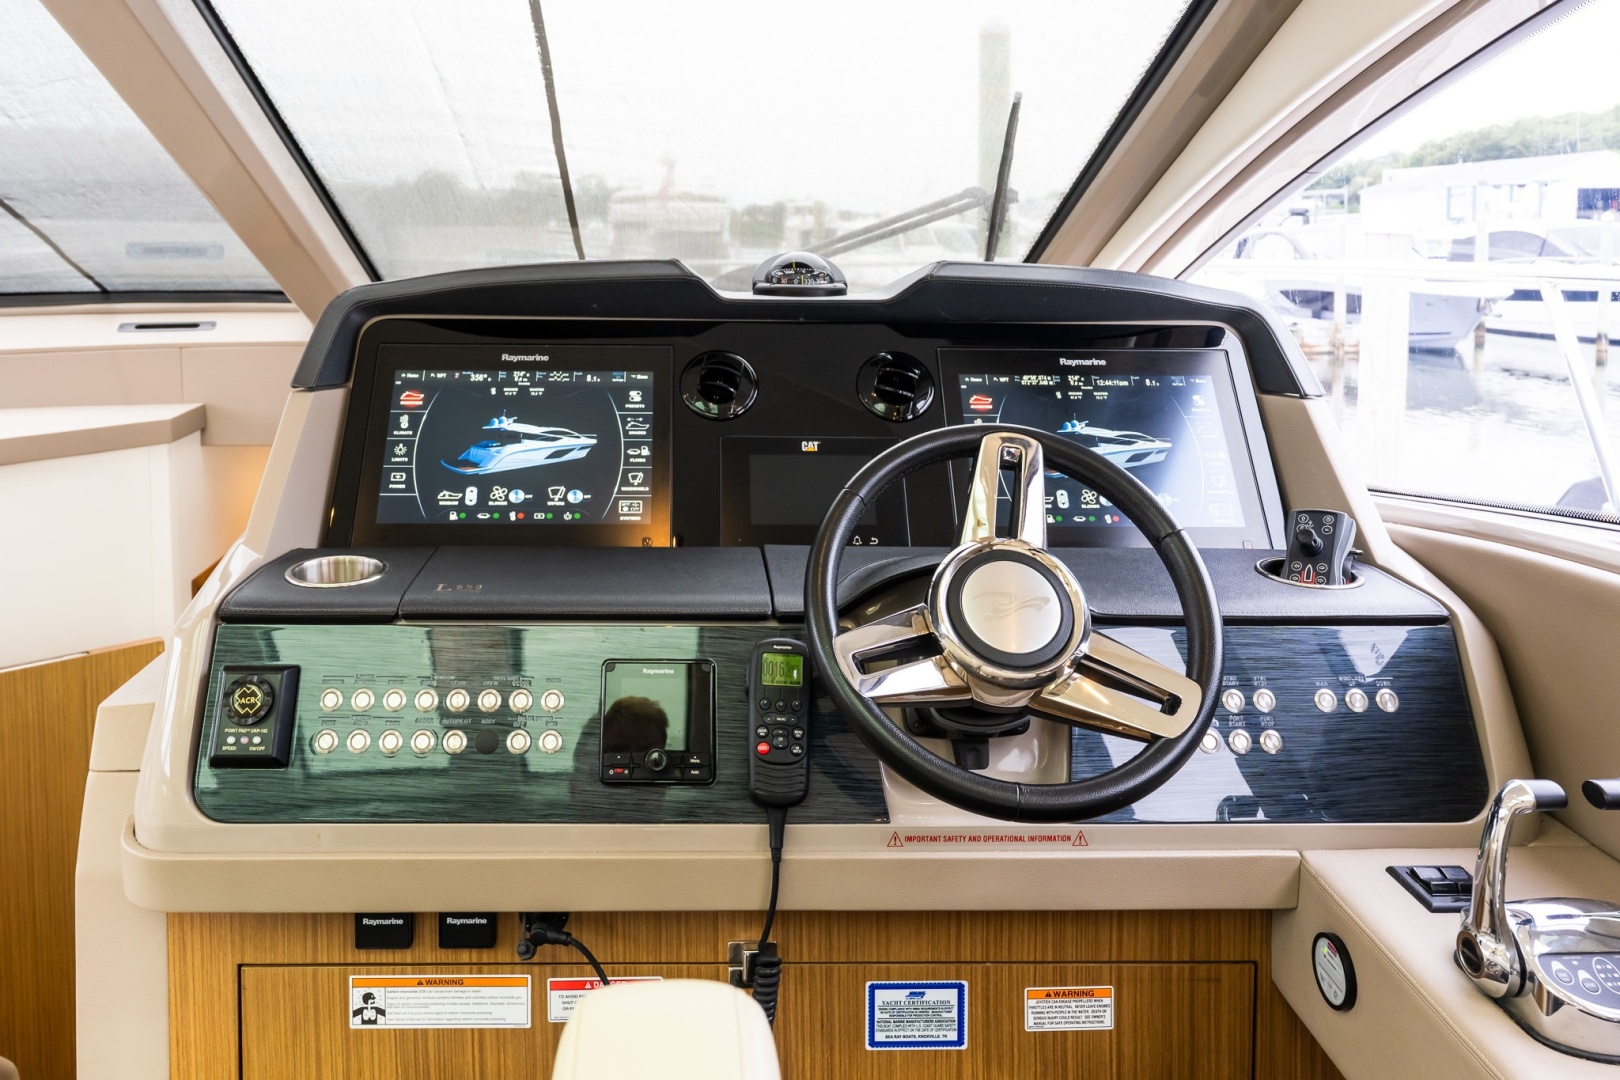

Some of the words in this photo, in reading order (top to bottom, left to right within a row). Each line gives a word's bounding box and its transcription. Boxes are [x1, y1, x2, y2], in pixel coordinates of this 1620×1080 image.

[501, 354, 549, 362] Raymarine
[1059, 358, 1106, 366] Raymarine
[1096, 379, 1129, 387] 12:44:11pm
[801, 441, 819, 451] CAT
[943, 835, 967, 843] SAFETY
[968, 835, 982, 843] AND
[983, 835, 1026, 843] OPERATIONAL
[1028, 834, 1072, 842] INFORMATION
[447, 917, 487, 925] Raymarine
[425, 978, 464, 986] WARNING
